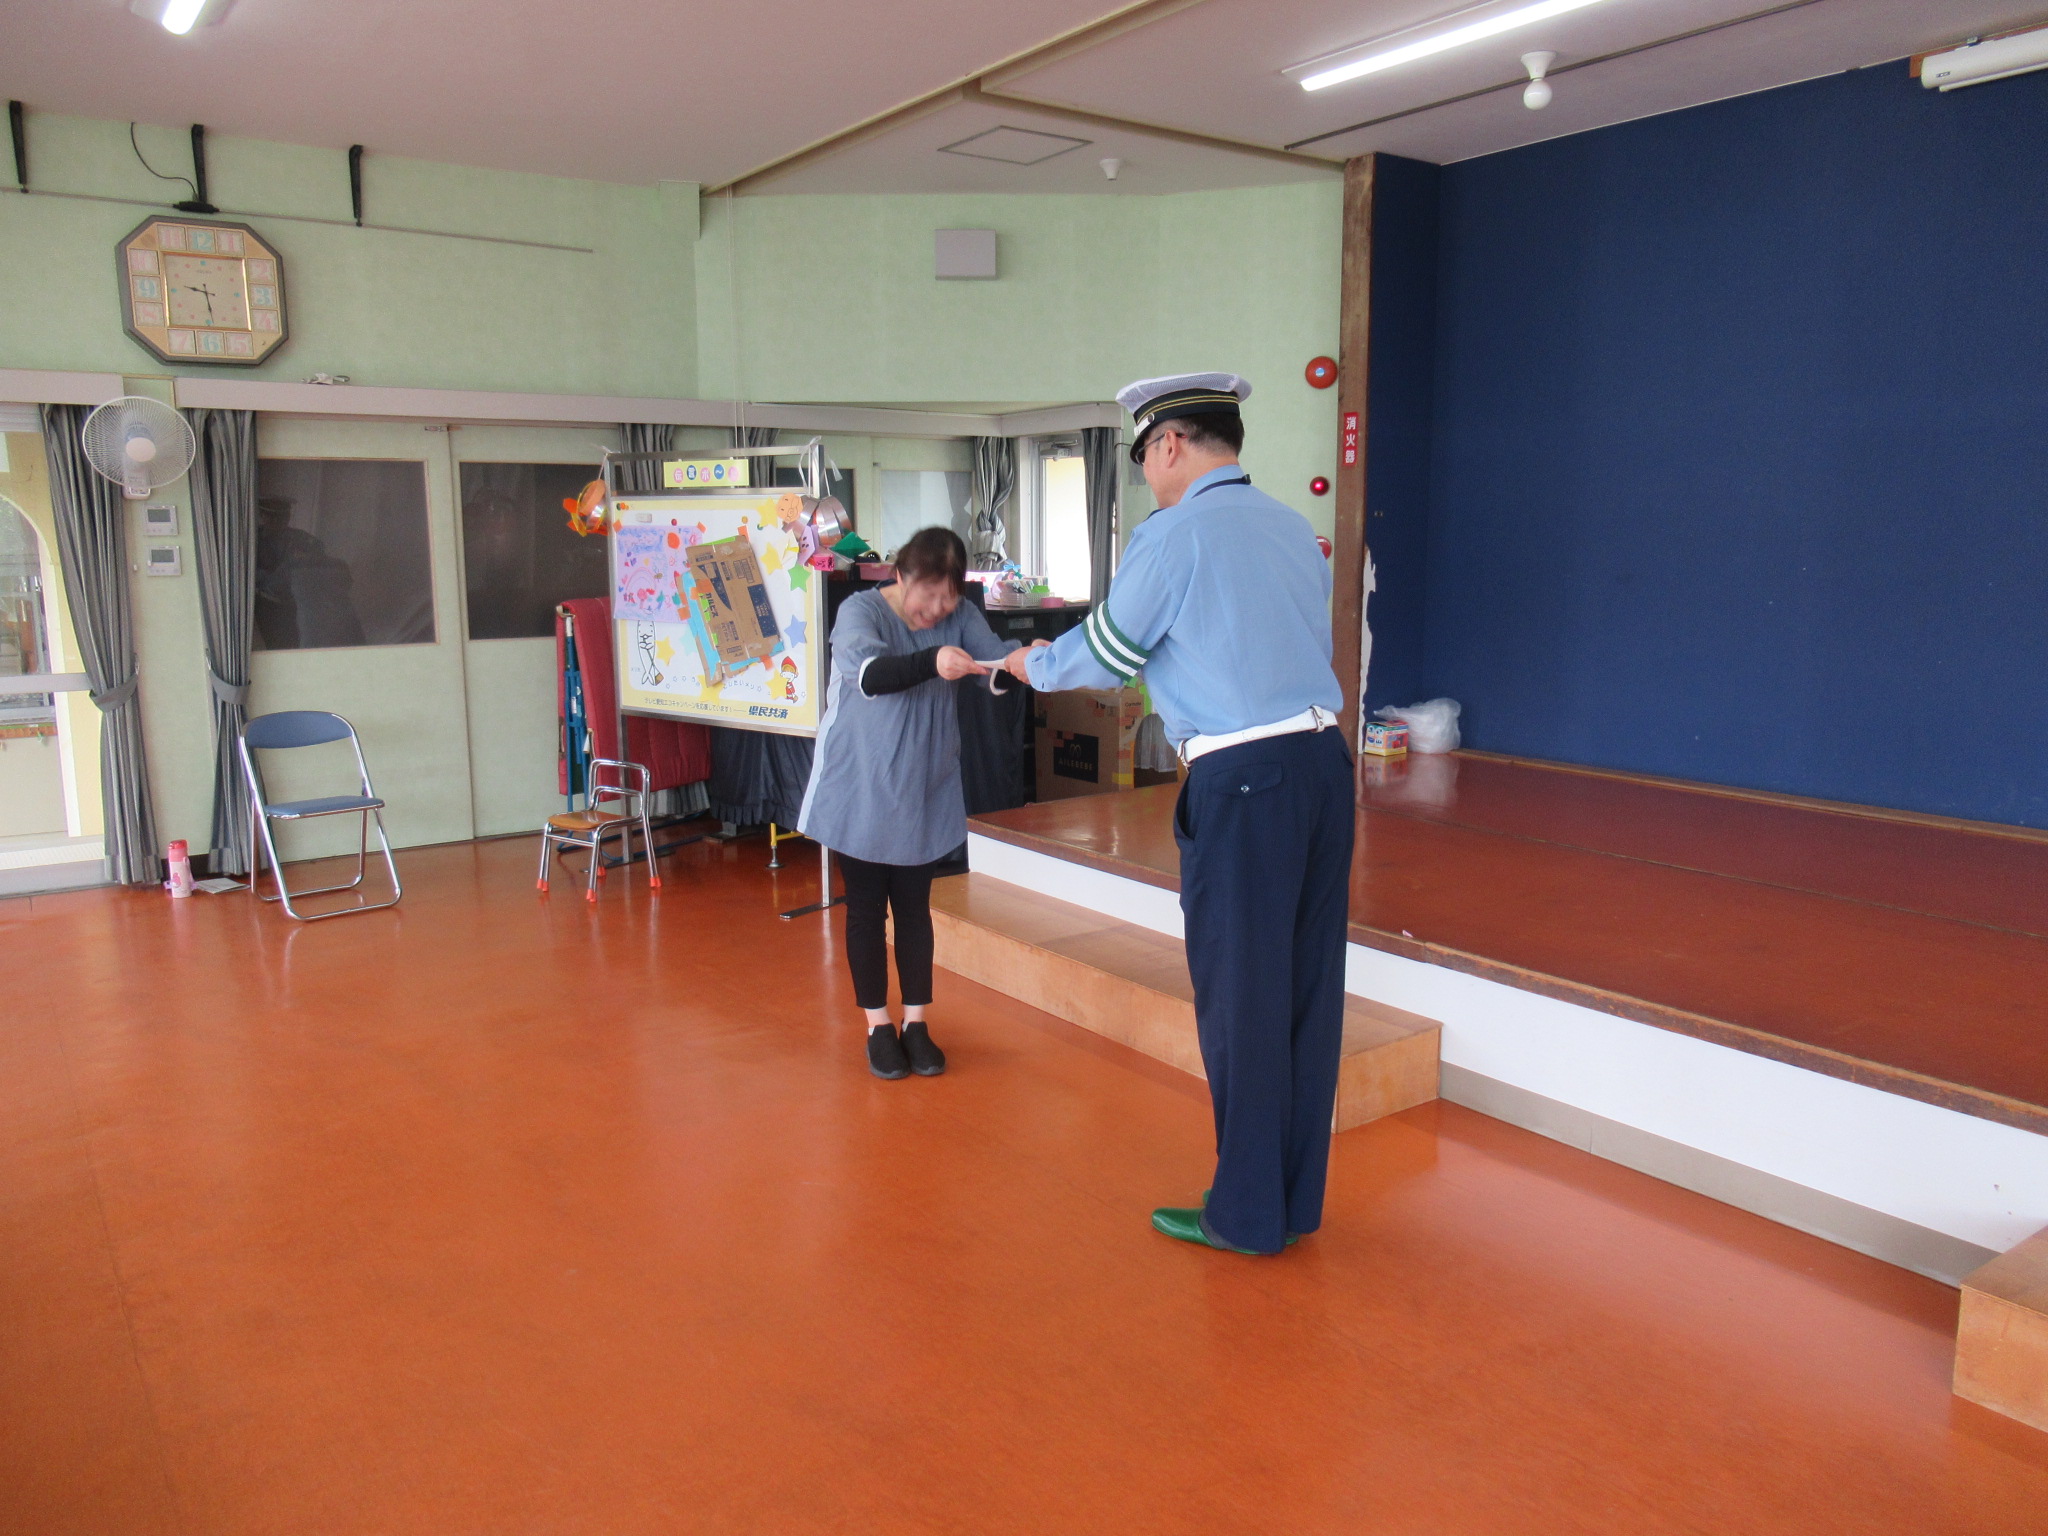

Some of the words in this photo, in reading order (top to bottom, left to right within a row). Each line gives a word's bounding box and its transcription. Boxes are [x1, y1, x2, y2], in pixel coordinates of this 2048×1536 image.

[191, 231, 214, 251] 12
[255, 260, 270, 281] 2
[138, 278, 157, 297] 9
[255, 287, 273, 305] 3
[174, 331, 189, 350] 7
[202, 334, 220, 353] 6
[235, 335, 249, 353] 5
[1345, 416, 1357, 464] 消火器
[748, 705, 789, 719] 県民共済
